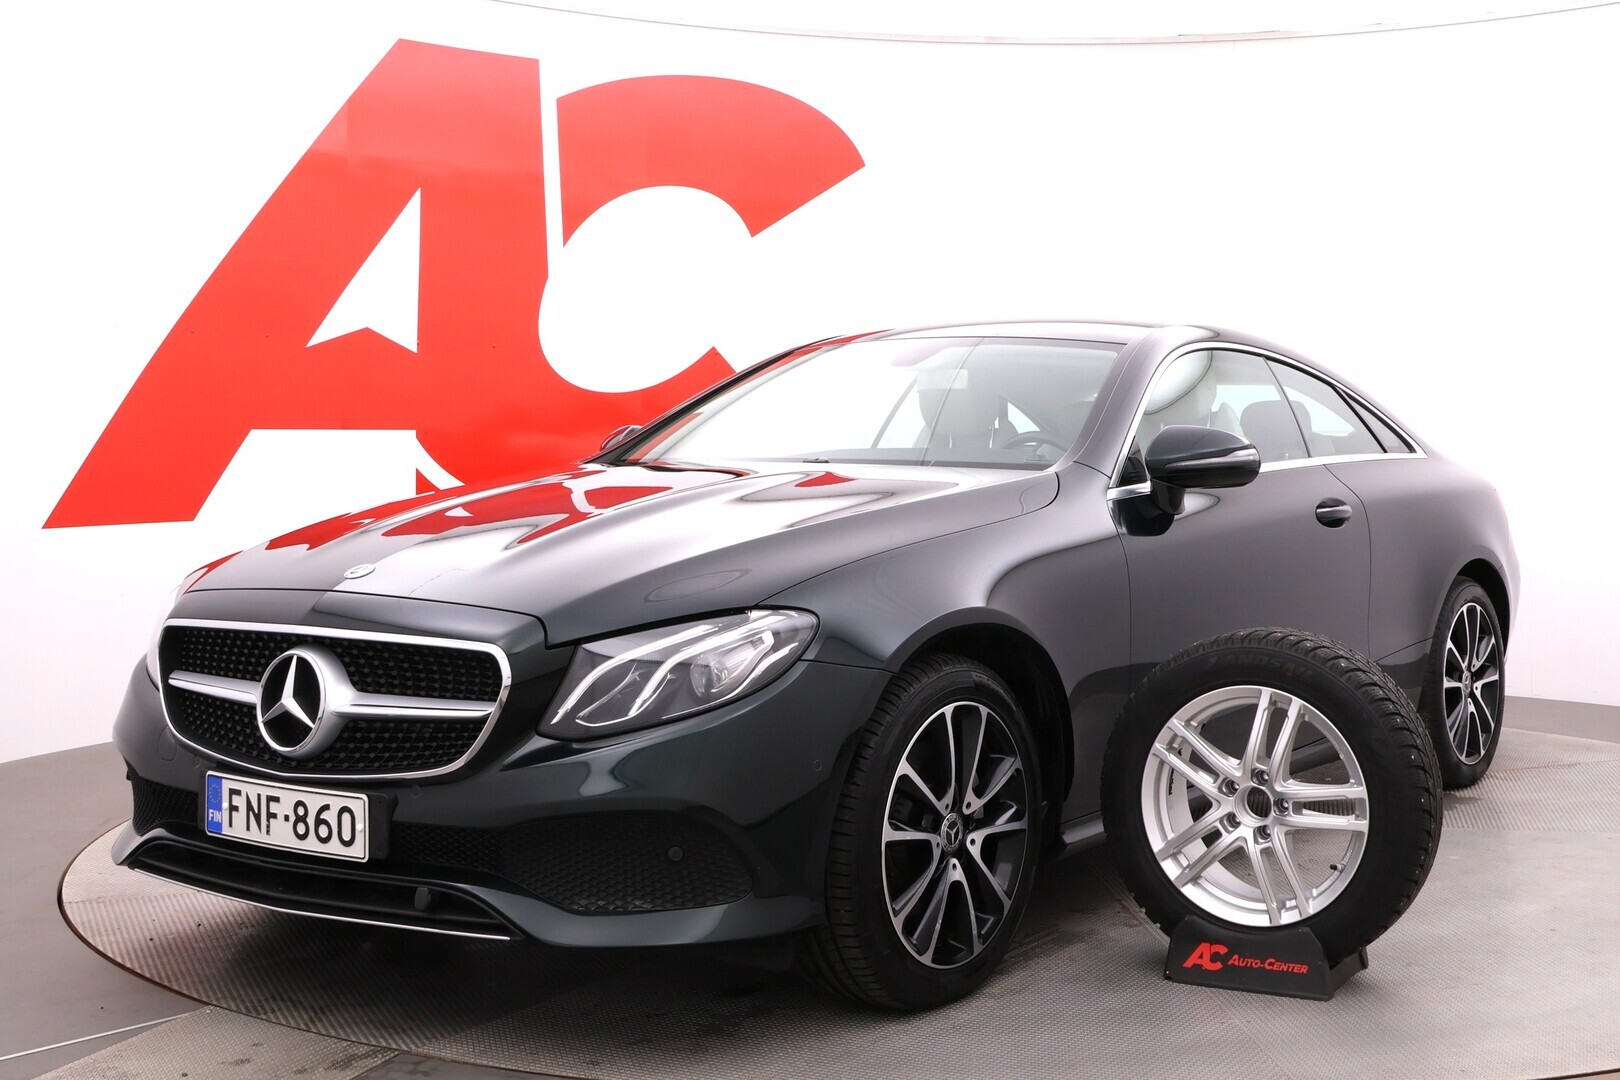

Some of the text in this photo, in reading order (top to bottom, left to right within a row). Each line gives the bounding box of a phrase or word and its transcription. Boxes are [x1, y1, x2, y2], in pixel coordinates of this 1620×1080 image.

[42, 39, 865, 528] AC
[208, 809, 222, 823] FIN
[228, 787, 356, 848] FNF-860
[1183, 942, 1229, 972] AC
